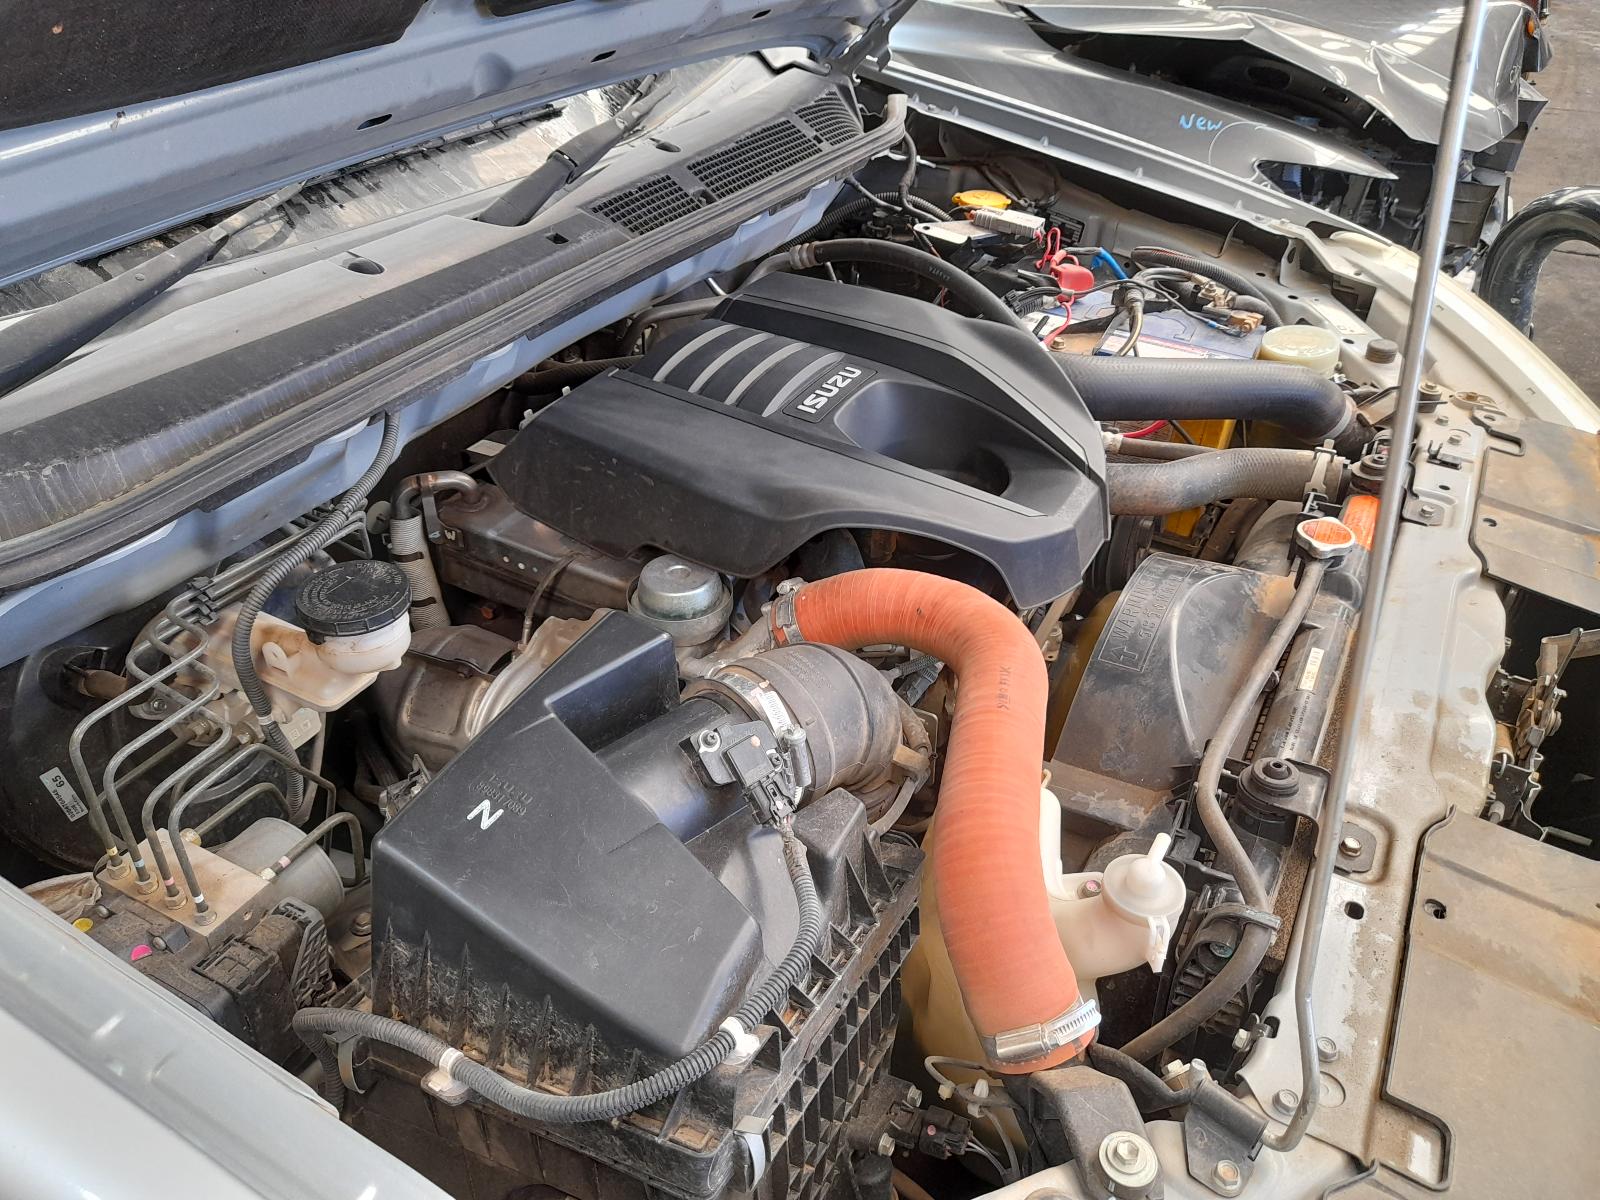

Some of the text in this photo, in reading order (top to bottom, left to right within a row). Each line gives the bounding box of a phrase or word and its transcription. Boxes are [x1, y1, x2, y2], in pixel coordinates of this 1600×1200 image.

[1179, 113, 1223, 131] New
[796, 366, 862, 414] ISUZU
[1112, 580, 1156, 639] WARNING
[52, 775, 65, 788] 65
